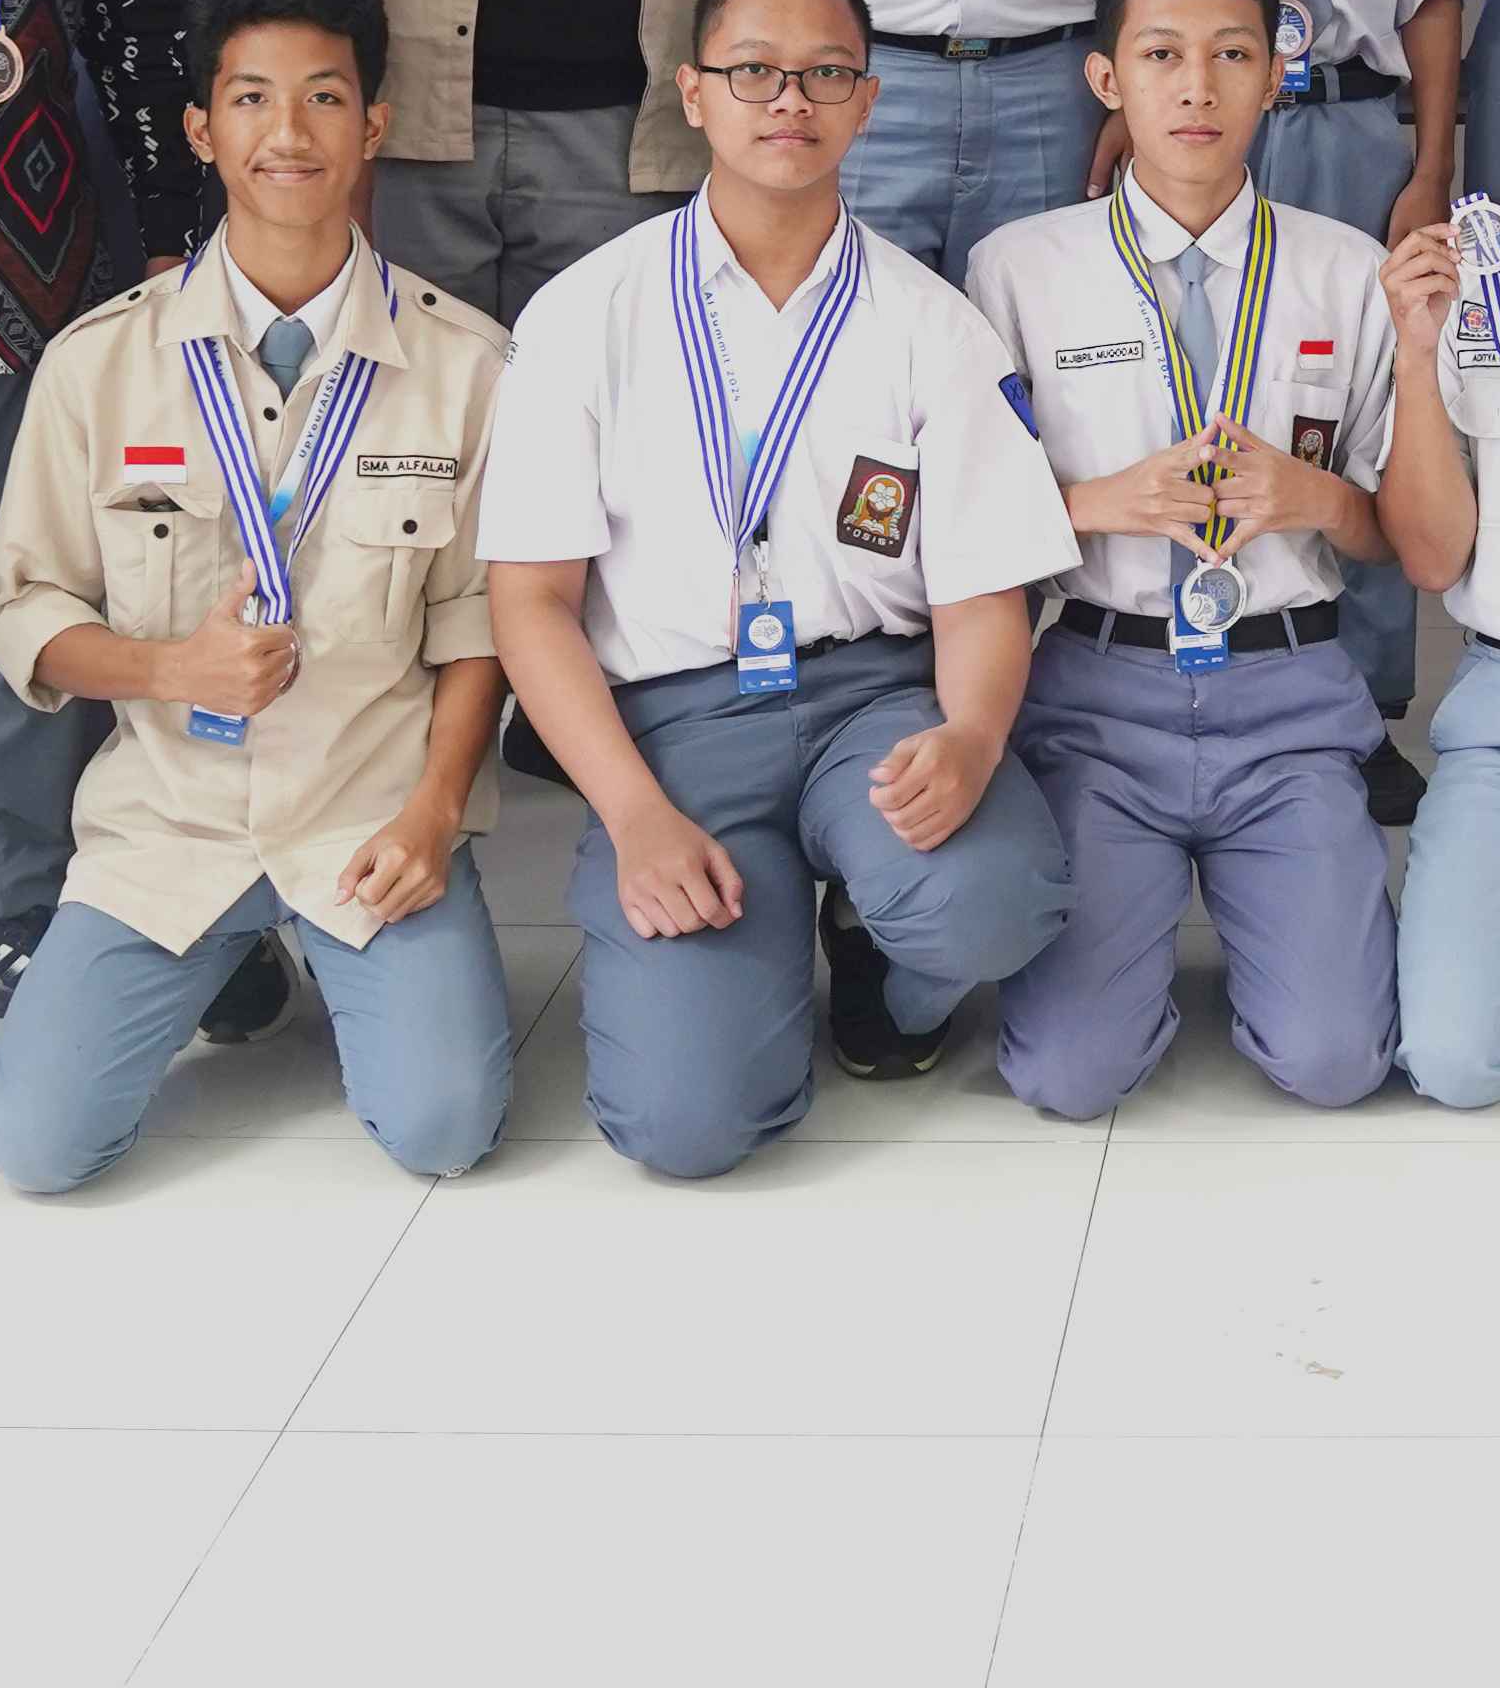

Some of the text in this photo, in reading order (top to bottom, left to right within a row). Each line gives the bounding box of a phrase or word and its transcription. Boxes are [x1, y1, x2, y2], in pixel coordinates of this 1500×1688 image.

[703, 291, 741, 403] AI Summit 2024
[1137, 300, 1161, 352] Summit
[1157, 357, 1172, 389] 2024
[1472, 353, 1498, 362] ADITYA
[361, 459, 456, 474] SMA ALFALAH
[852, 528, 886, 546] OSIS
